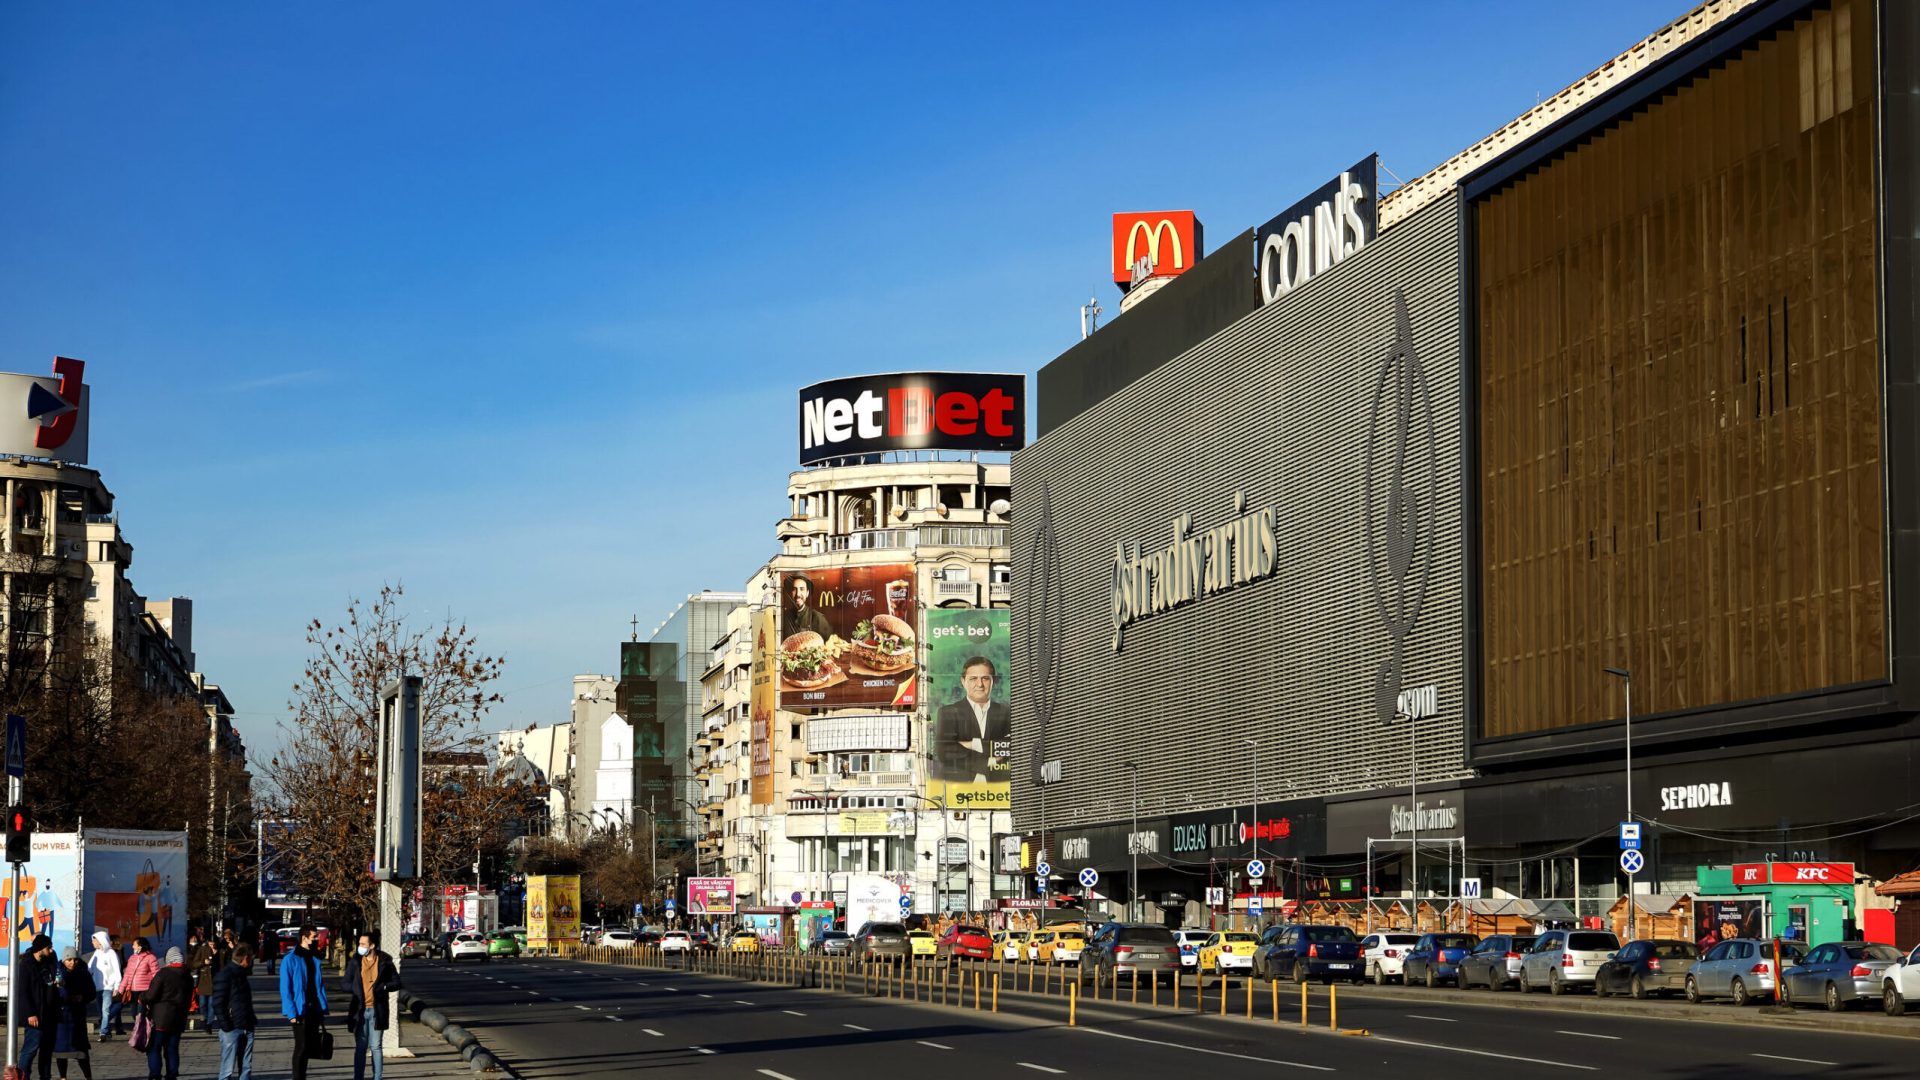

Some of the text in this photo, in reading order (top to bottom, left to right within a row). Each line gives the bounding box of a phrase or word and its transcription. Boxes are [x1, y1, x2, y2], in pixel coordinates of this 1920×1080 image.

[804, 387, 1015, 450] NetBet
[932, 624, 990, 639] get's bet
[1661, 781, 1732, 811] SEPHORA
[1174, 823, 1207, 852] DOUGLAS
[32, 842, 71, 850] CUM VREA
[1744, 868, 1757, 880] KFC
[1796, 868, 1829, 880] KFC
[1464, 881, 1478, 897] M
